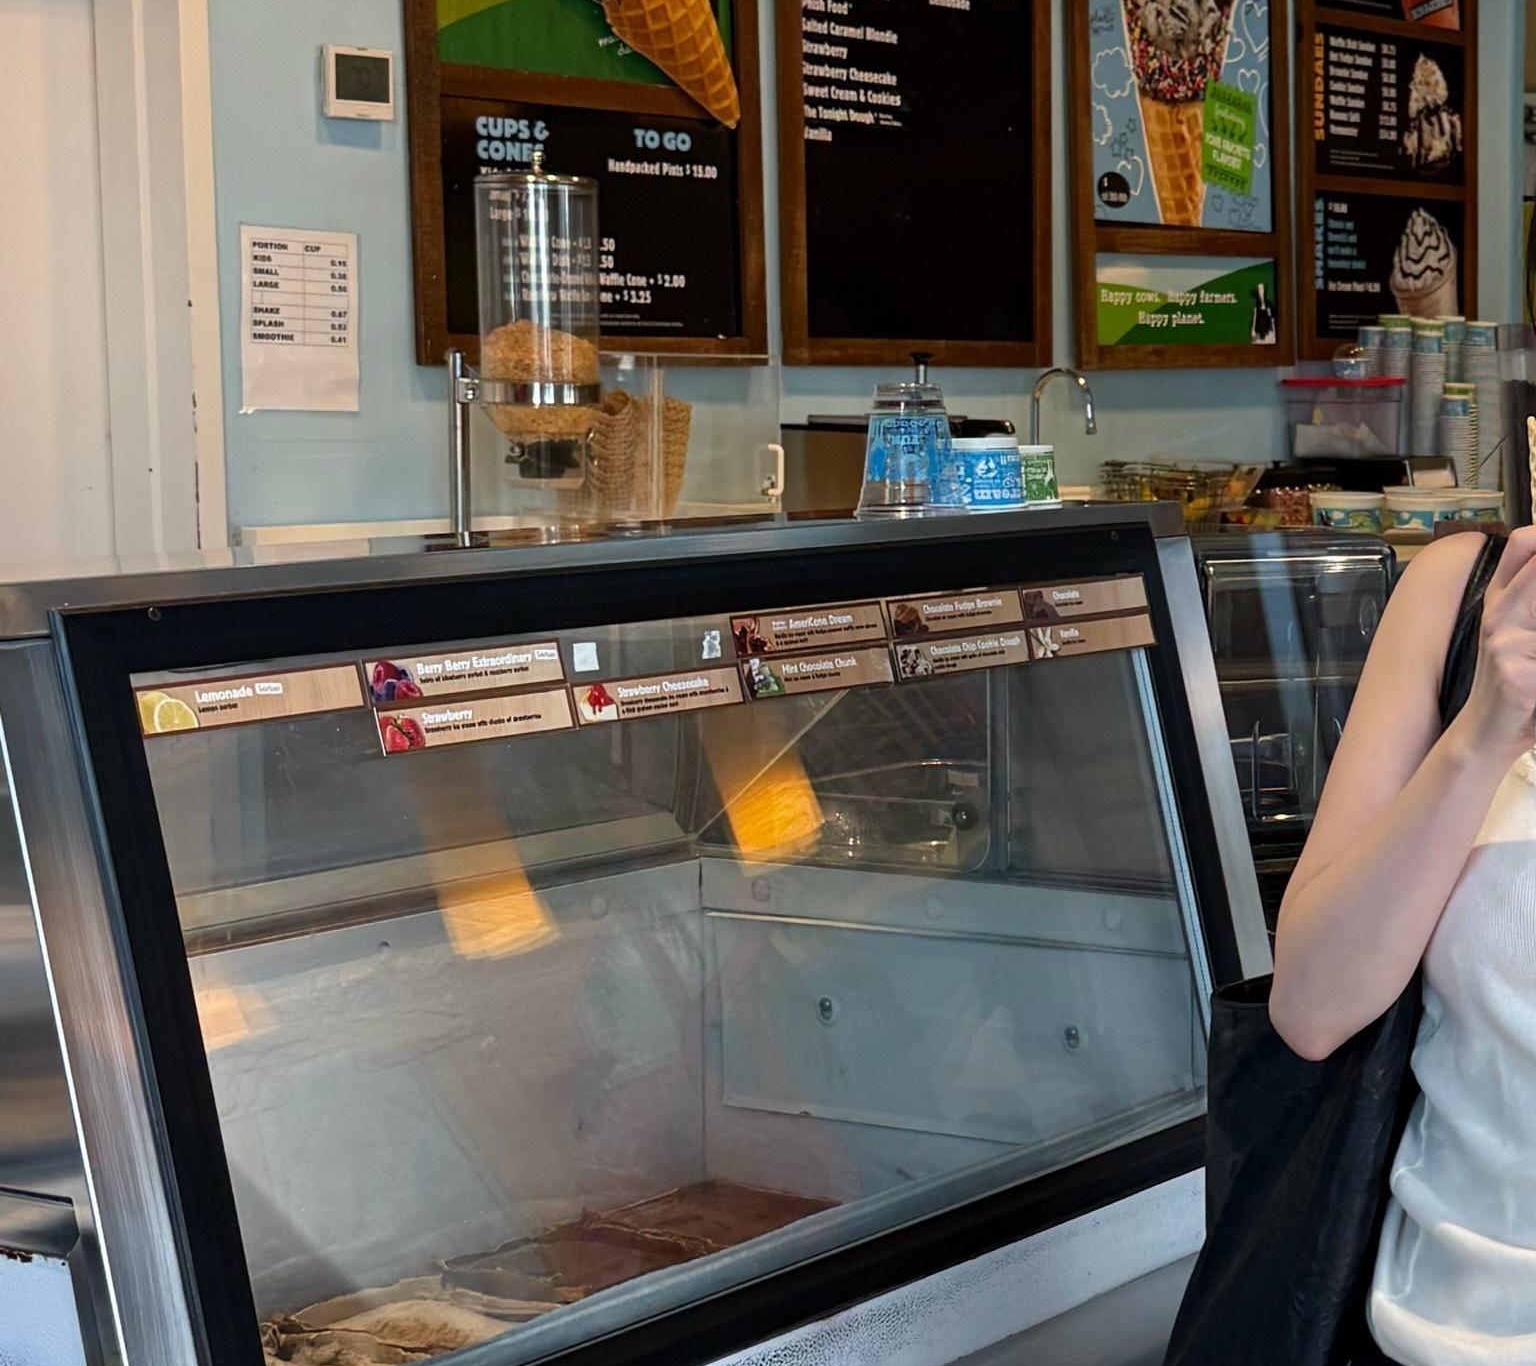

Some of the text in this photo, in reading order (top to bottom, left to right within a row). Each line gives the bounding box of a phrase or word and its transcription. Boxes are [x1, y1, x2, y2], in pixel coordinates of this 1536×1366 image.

[802, 16, 899, 45] Salted Caramel Blondie
[802, 38, 848, 60] Strawberry
[802, 61, 898, 87] Strawberry Cheesecake
[803, 82, 902, 107] Sweet Cream & Cookies
[1314, 32, 1325, 141] SUNDAES
[803, 104, 818, 119] The
[818, 105, 848, 122] Tonight
[847, 108, 875, 124] Dough
[475, 116, 551, 142] CUPS &
[633, 129, 692, 152] TO GO
[608, 158, 660, 176] Handpacked
[662, 162, 684, 177] Pints
[252, 241, 288, 250] PORTION
[304, 245, 321, 253] CUP
[253, 254, 272, 262] KIDS
[253, 267, 279, 276] SMALL
[253, 280, 279, 288] LARGE
[626, 273, 647, 288] Cone
[1101, 289, 1132, 305] Happy
[1167, 290, 1197, 305] Happy
[1199, 290, 1238, 304] farmers.
[253, 306, 280, 315] SHAKE
[253, 319, 284, 327] SPLASH
[1138, 311, 1169, 327] Happy
[252, 333, 294, 341] SMOOTHIE
[923, 602, 954, 614] Chocolate
[954, 600, 976, 612] Fudge
[788, 614, 854, 630] AmeriCone Dream
[930, 643, 962, 656] Chocolate
[962, 641, 977, 652] Chip
[416, 653, 532, 675] Berry Berry Extraordinary
[782, 656, 857, 675] Mint Chocolate Chunk
[195, 685, 253, 704] Lemonade
[618, 675, 709, 698] Strawberry Cheesecake
[422, 708, 473, 725] Strawberry
